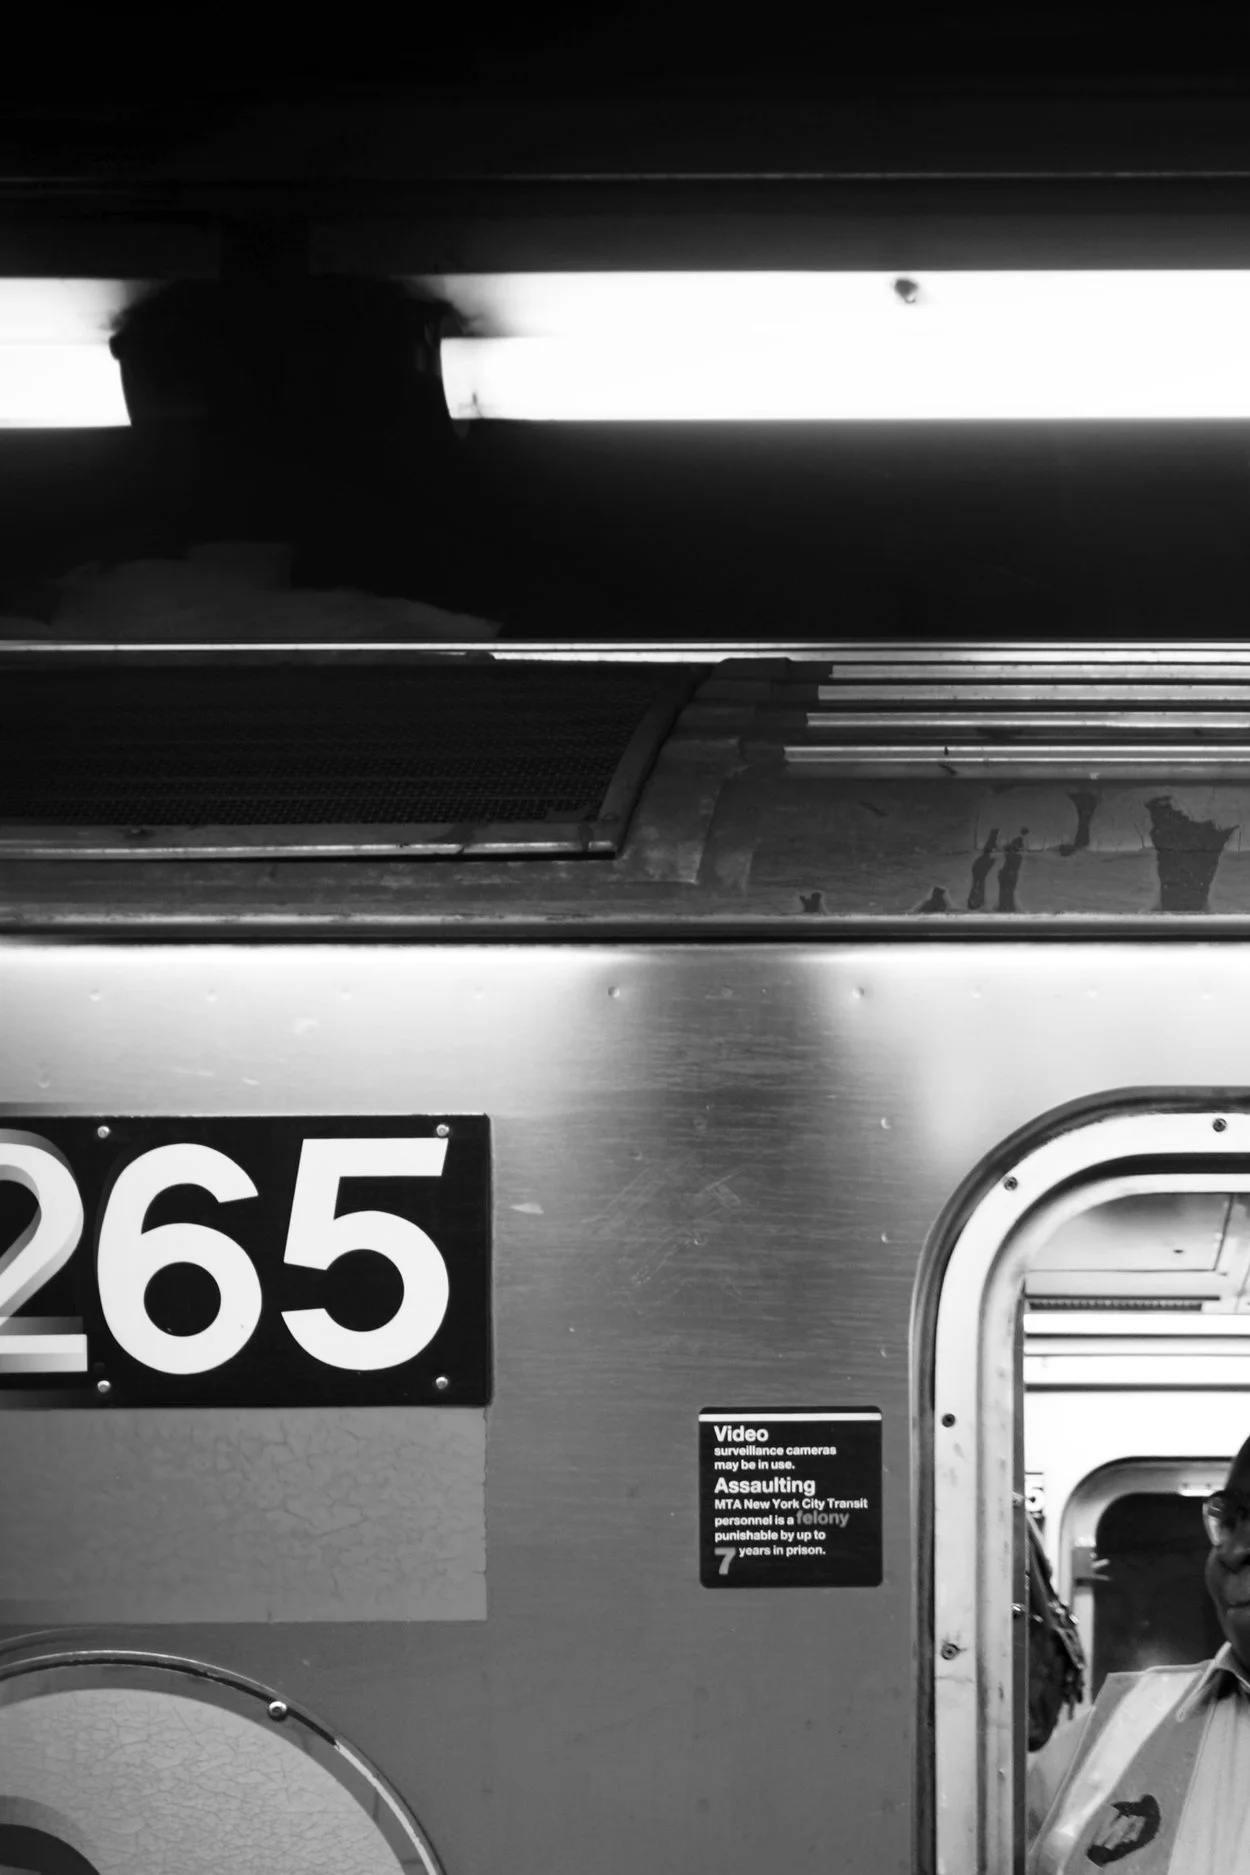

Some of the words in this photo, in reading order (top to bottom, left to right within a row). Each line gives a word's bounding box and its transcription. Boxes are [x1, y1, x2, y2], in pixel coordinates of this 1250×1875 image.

[714, 1425, 768, 1442] Video
[714, 1445, 784, 1456] surveillance
[786, 1447, 836, 1455] cameras
[715, 1462, 739, 1472] may
[741, 1460, 756, 1470] be
[758, 1459, 769, 1469] in
[771, 1461, 795, 1469] use.
[714, 1477, 815, 1496] Assaulting
[715, 1499, 742, 1509] MTA
[744, 1499, 770, 1509] New
[772, 1499, 799, 1509] York
[802, 1498, 825, 1510] City
[827, 1498, 868, 1508] Transit
[715, 1515, 772, 1527] personnel
[775, 1515, 785, 1525] is
[787, 1517, 794, 1525] a
[796, 1511, 849, 1527] felony
[715, 1531, 778, 1542] punishable
[781, 1530, 794, 1542] by
[797, 1532, 812, 1542] up
[814, 1531, 825, 1539] to
[715, 1547, 736, 1574] 7
[739, 1547, 771, 1557] years
[773, 1546, 783, 1555] in
[786, 1545, 825, 1557] prison.
